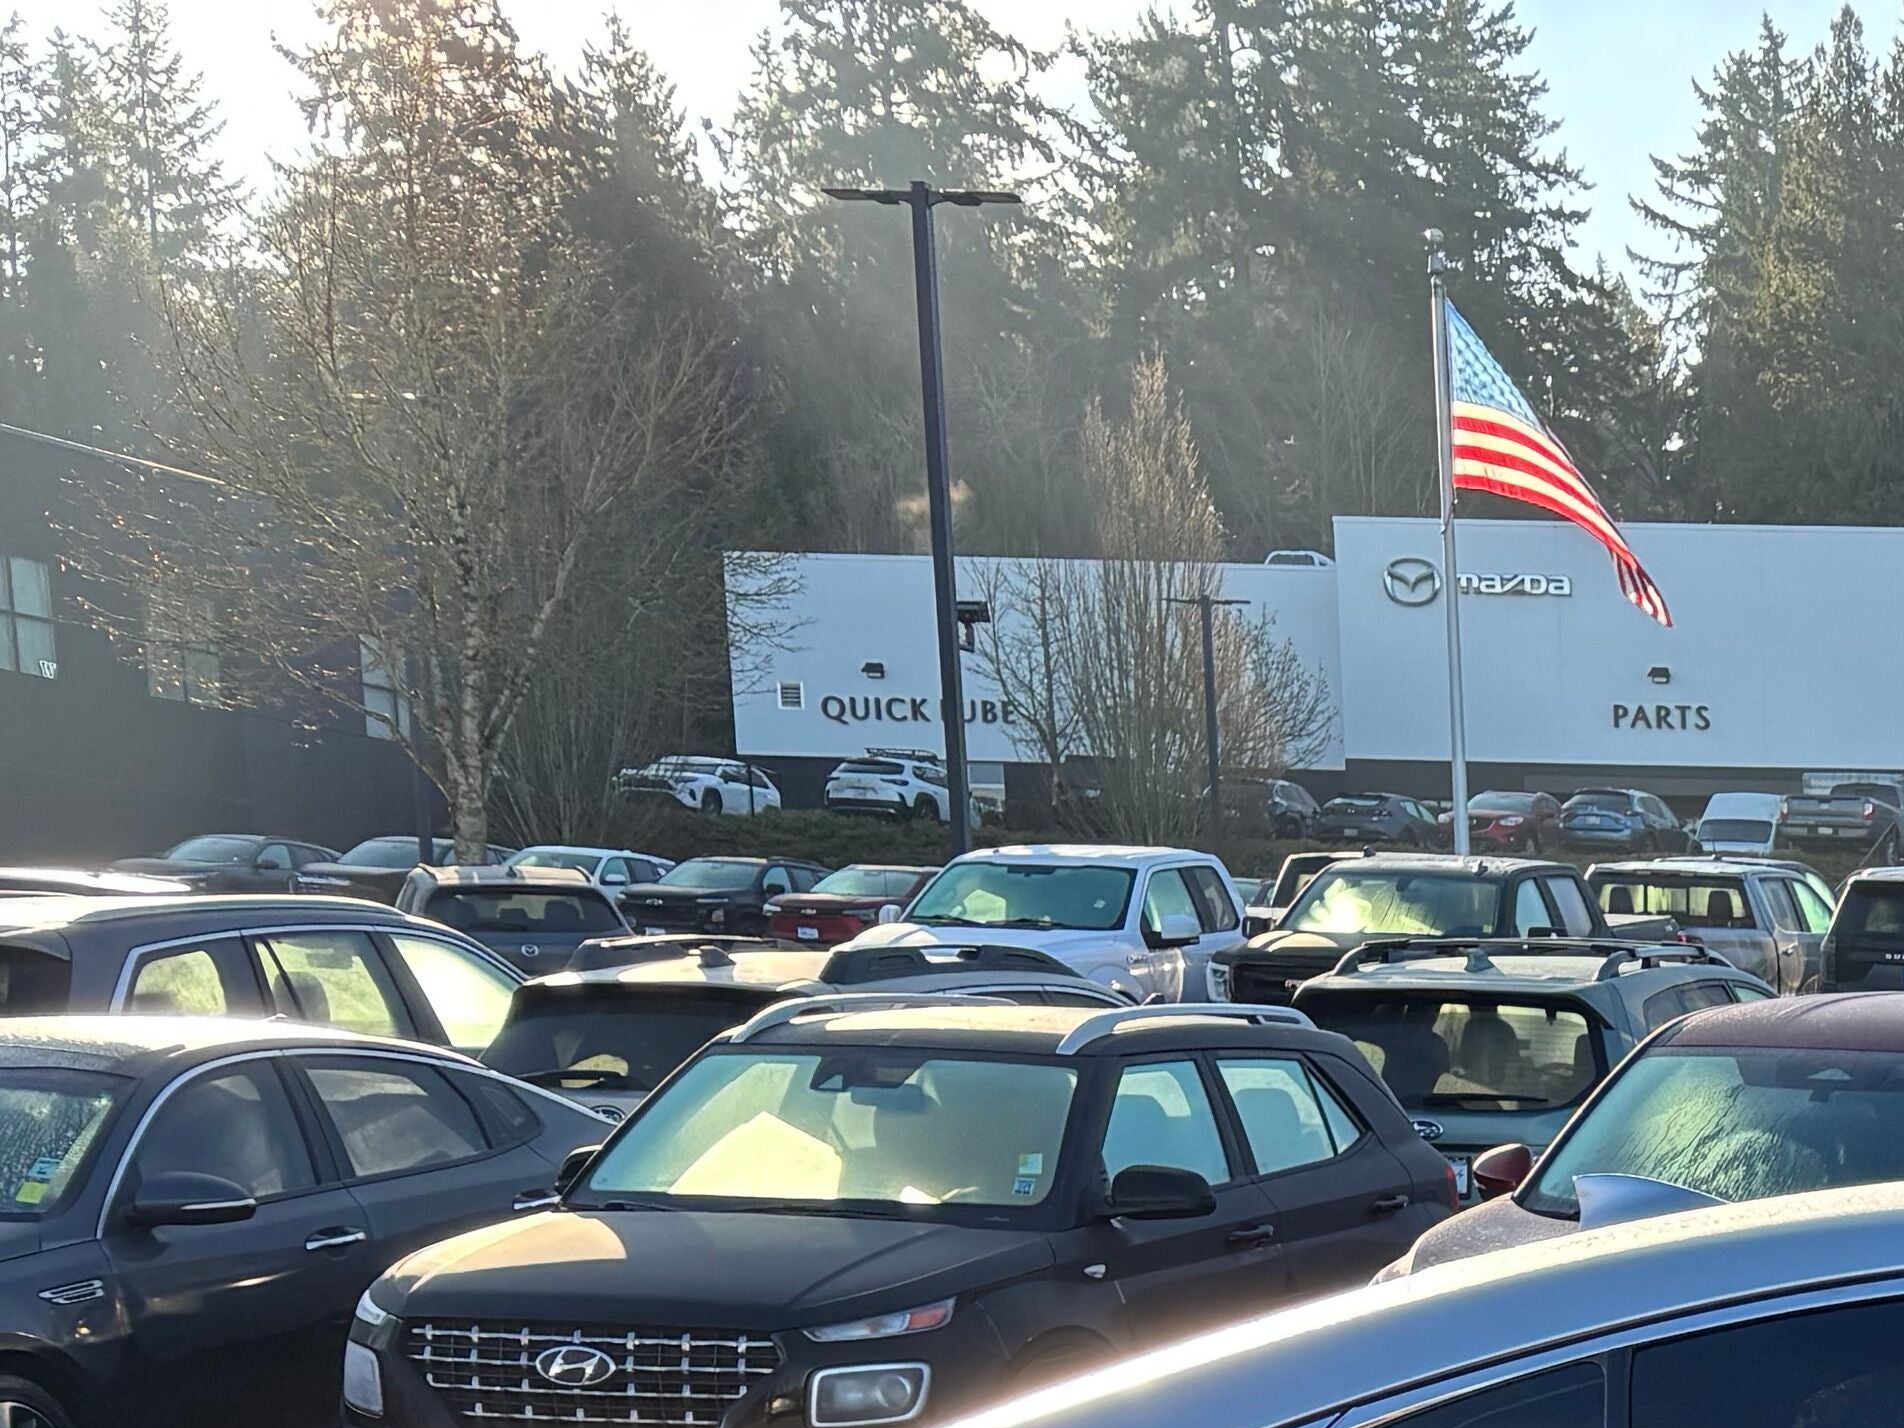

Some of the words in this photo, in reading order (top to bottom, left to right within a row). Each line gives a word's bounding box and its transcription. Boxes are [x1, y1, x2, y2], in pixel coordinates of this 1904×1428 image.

[821, 695, 931, 725] QUICK
[941, 699, 1017, 725] UBE
[1612, 704, 1711, 731] PARTS
